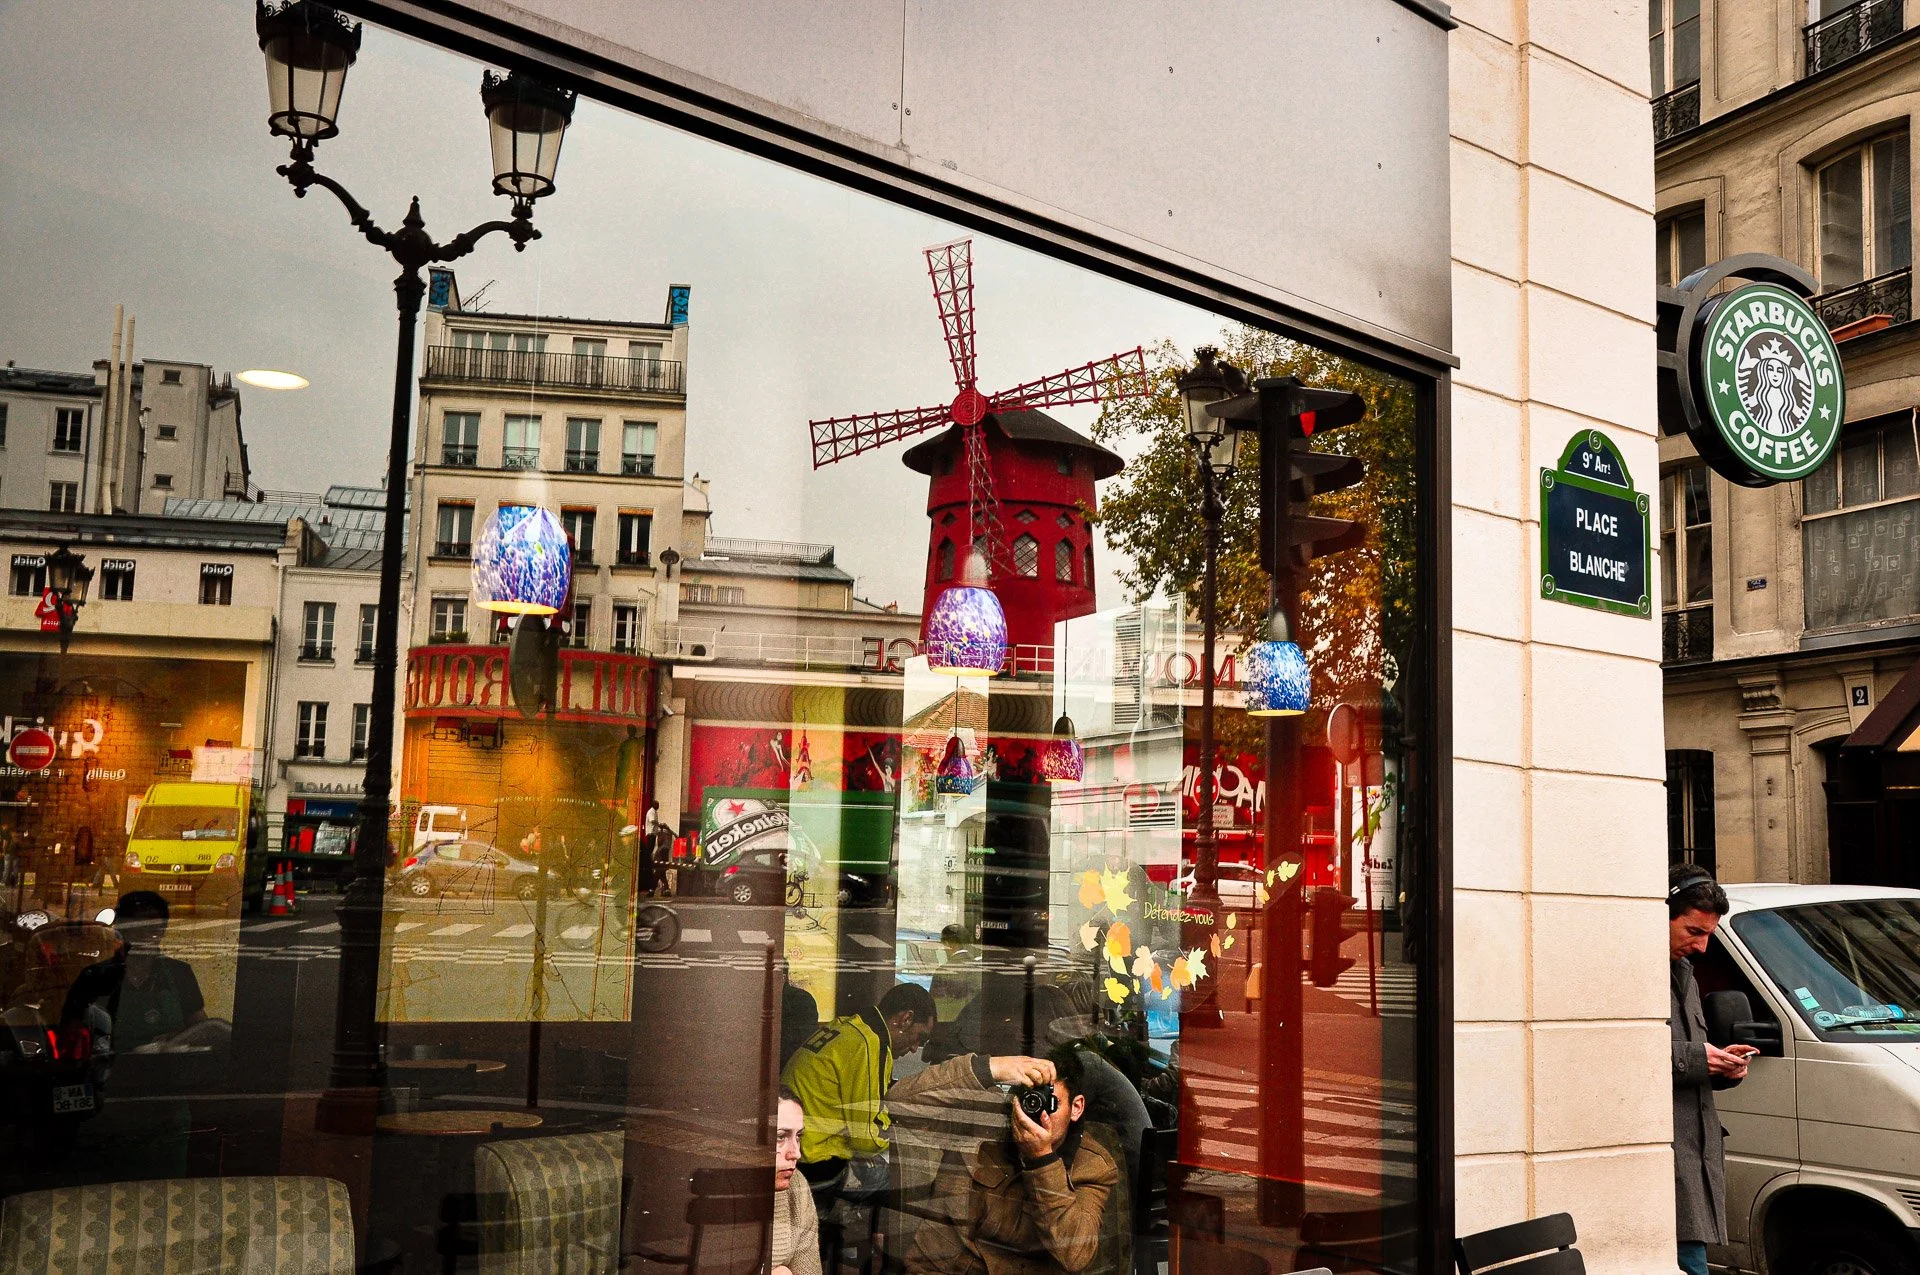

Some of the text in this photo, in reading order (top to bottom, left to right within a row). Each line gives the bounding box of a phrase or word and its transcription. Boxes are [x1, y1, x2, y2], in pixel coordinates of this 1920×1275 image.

[1715, 301, 1833, 387] STARBUCKS
[1728, 410, 1819, 465] COFFEE
[1576, 507, 1618, 537] PLACE
[1569, 550, 1626, 582] BLANCHE
[1855, 689, 1865, 704] 2
[1143, 901, 1214, 926] Détendez-vous
